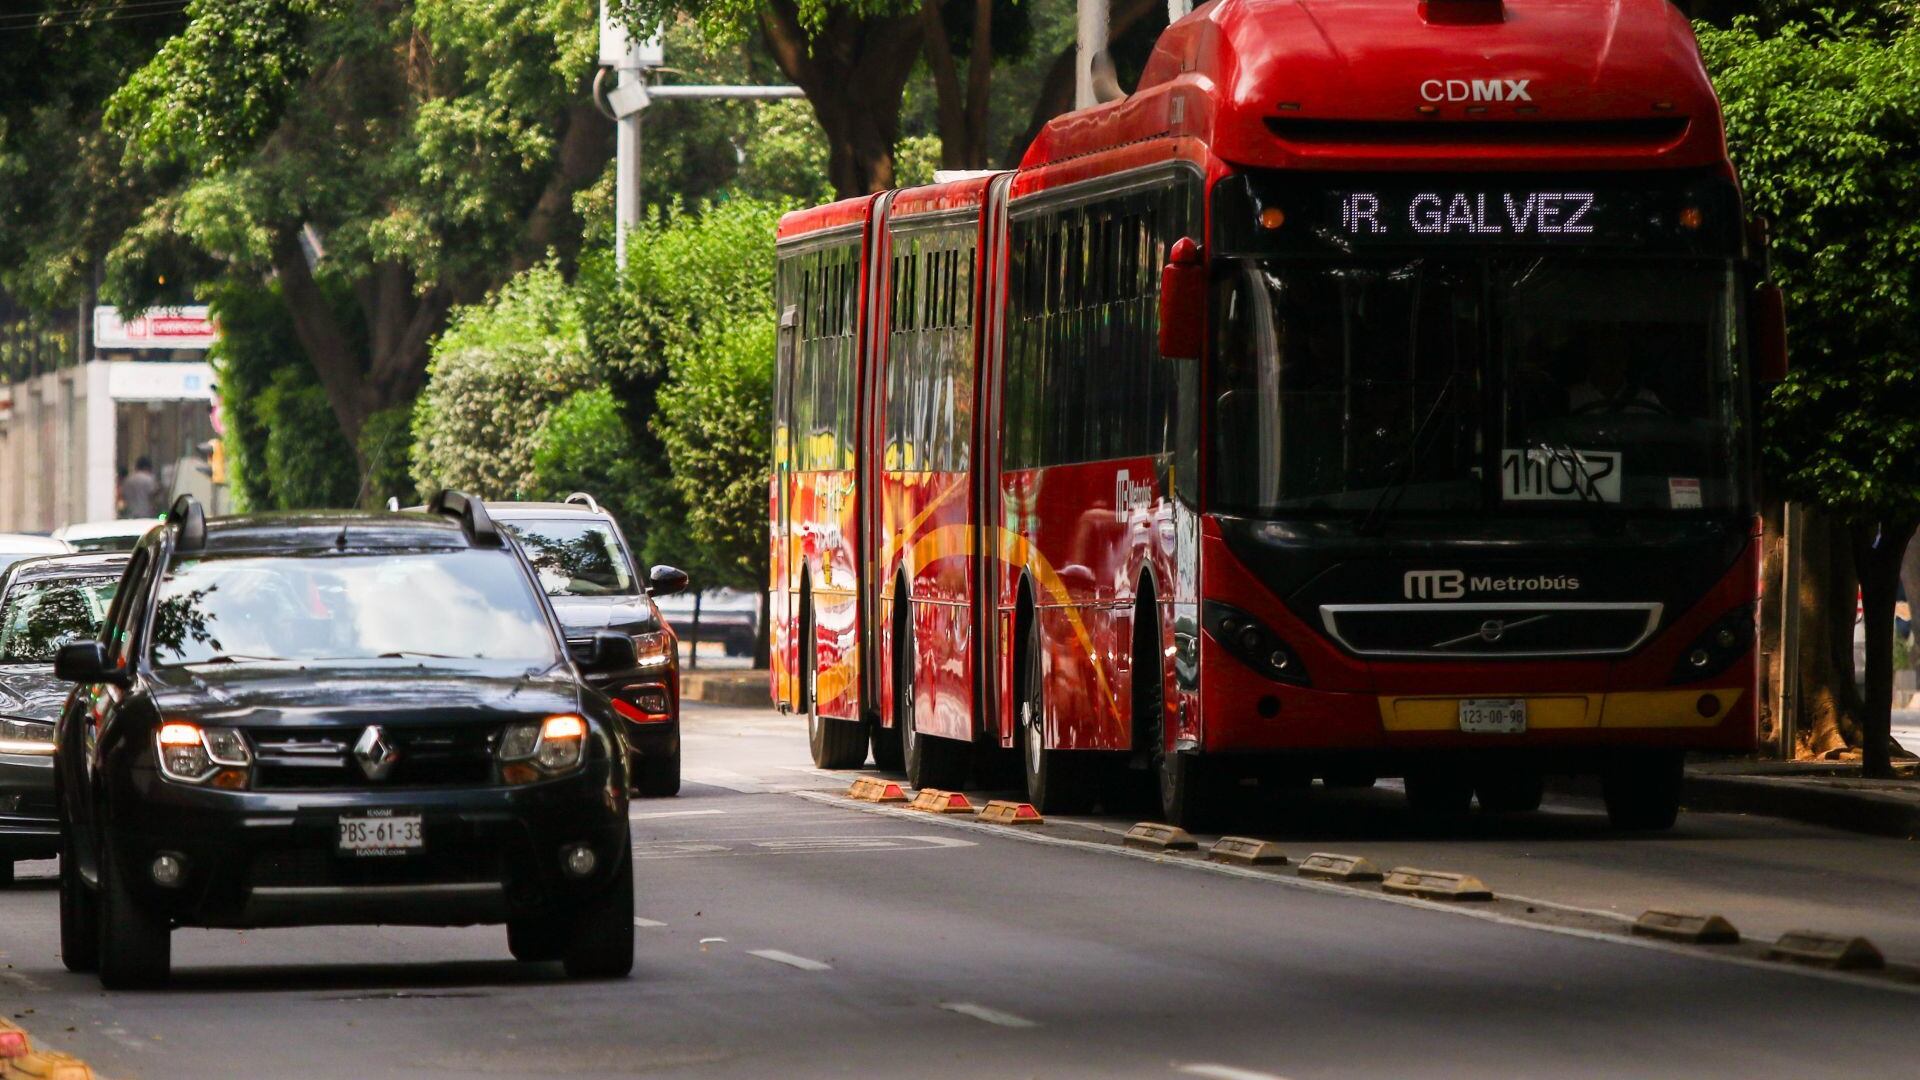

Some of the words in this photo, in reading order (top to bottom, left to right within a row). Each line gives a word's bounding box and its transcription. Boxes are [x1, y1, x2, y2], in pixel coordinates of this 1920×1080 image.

[1420, 79, 1532, 102] CDMX
[1408, 192, 1595, 233] GALVEZ
[1470, 575, 1580, 591] Metrobús
[339, 822, 421, 842] PBS-61-33
